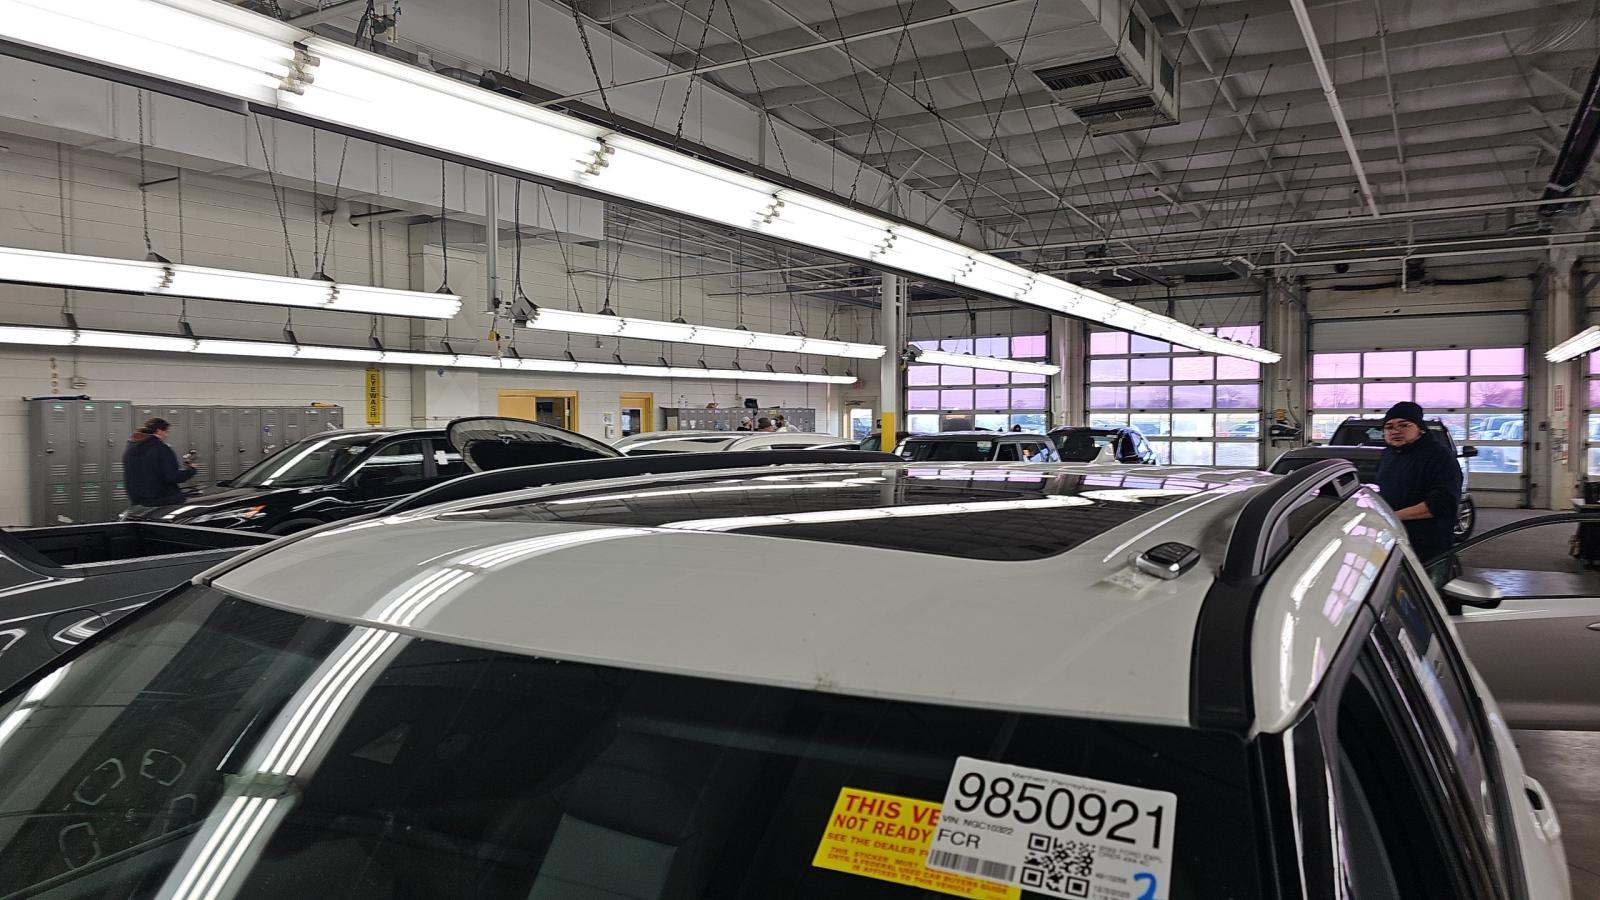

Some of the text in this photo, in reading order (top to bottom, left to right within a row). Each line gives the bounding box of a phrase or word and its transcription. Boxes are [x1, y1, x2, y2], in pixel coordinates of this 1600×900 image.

[846, 794, 902, 819] THIS
[954, 772, 1164, 849] 9850921
[834, 814, 932, 843] NOT READY
[937, 828, 981, 849] FCR
[826, 832, 848, 842] SEE
[850, 836, 871, 847] THE
[873, 841, 916, 855] DEALER
